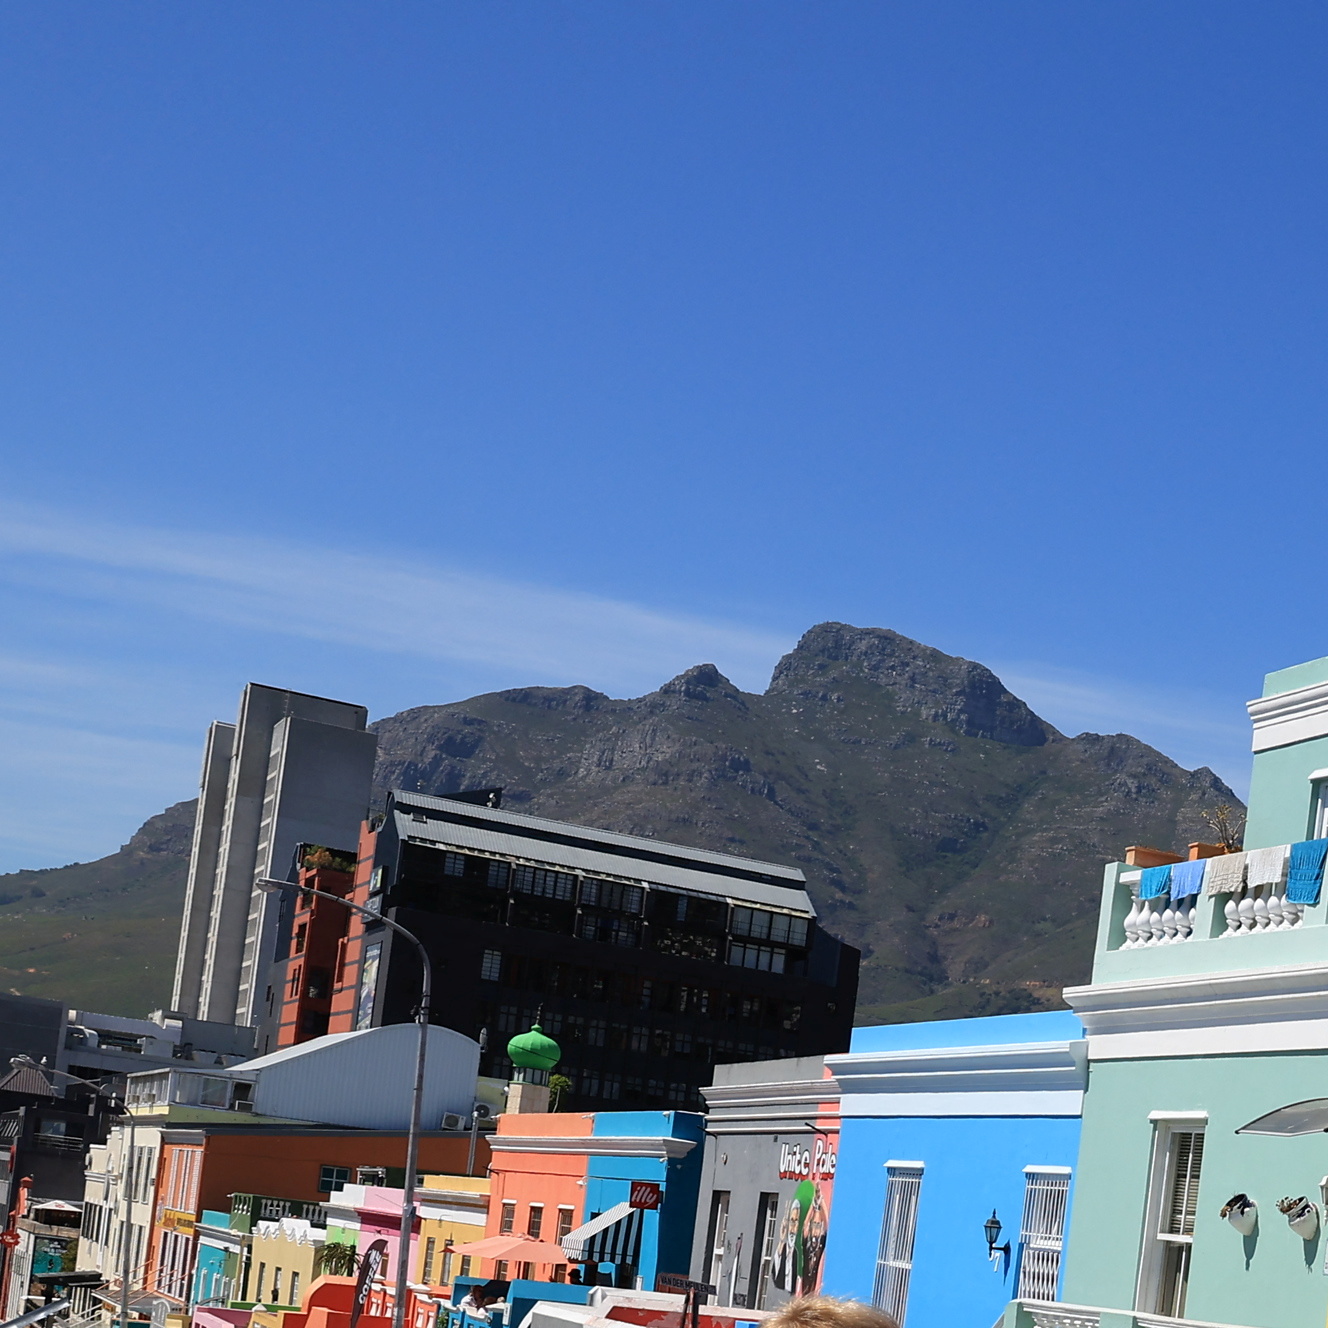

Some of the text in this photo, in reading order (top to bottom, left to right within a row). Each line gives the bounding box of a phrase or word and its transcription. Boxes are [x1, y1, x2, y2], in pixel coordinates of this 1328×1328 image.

[779, 1138, 836, 1180] Unite Pale
[631, 1185, 658, 1208] illy
[661, 1276, 672, 1285] VAN
[672, 1278, 683, 1287] DER
